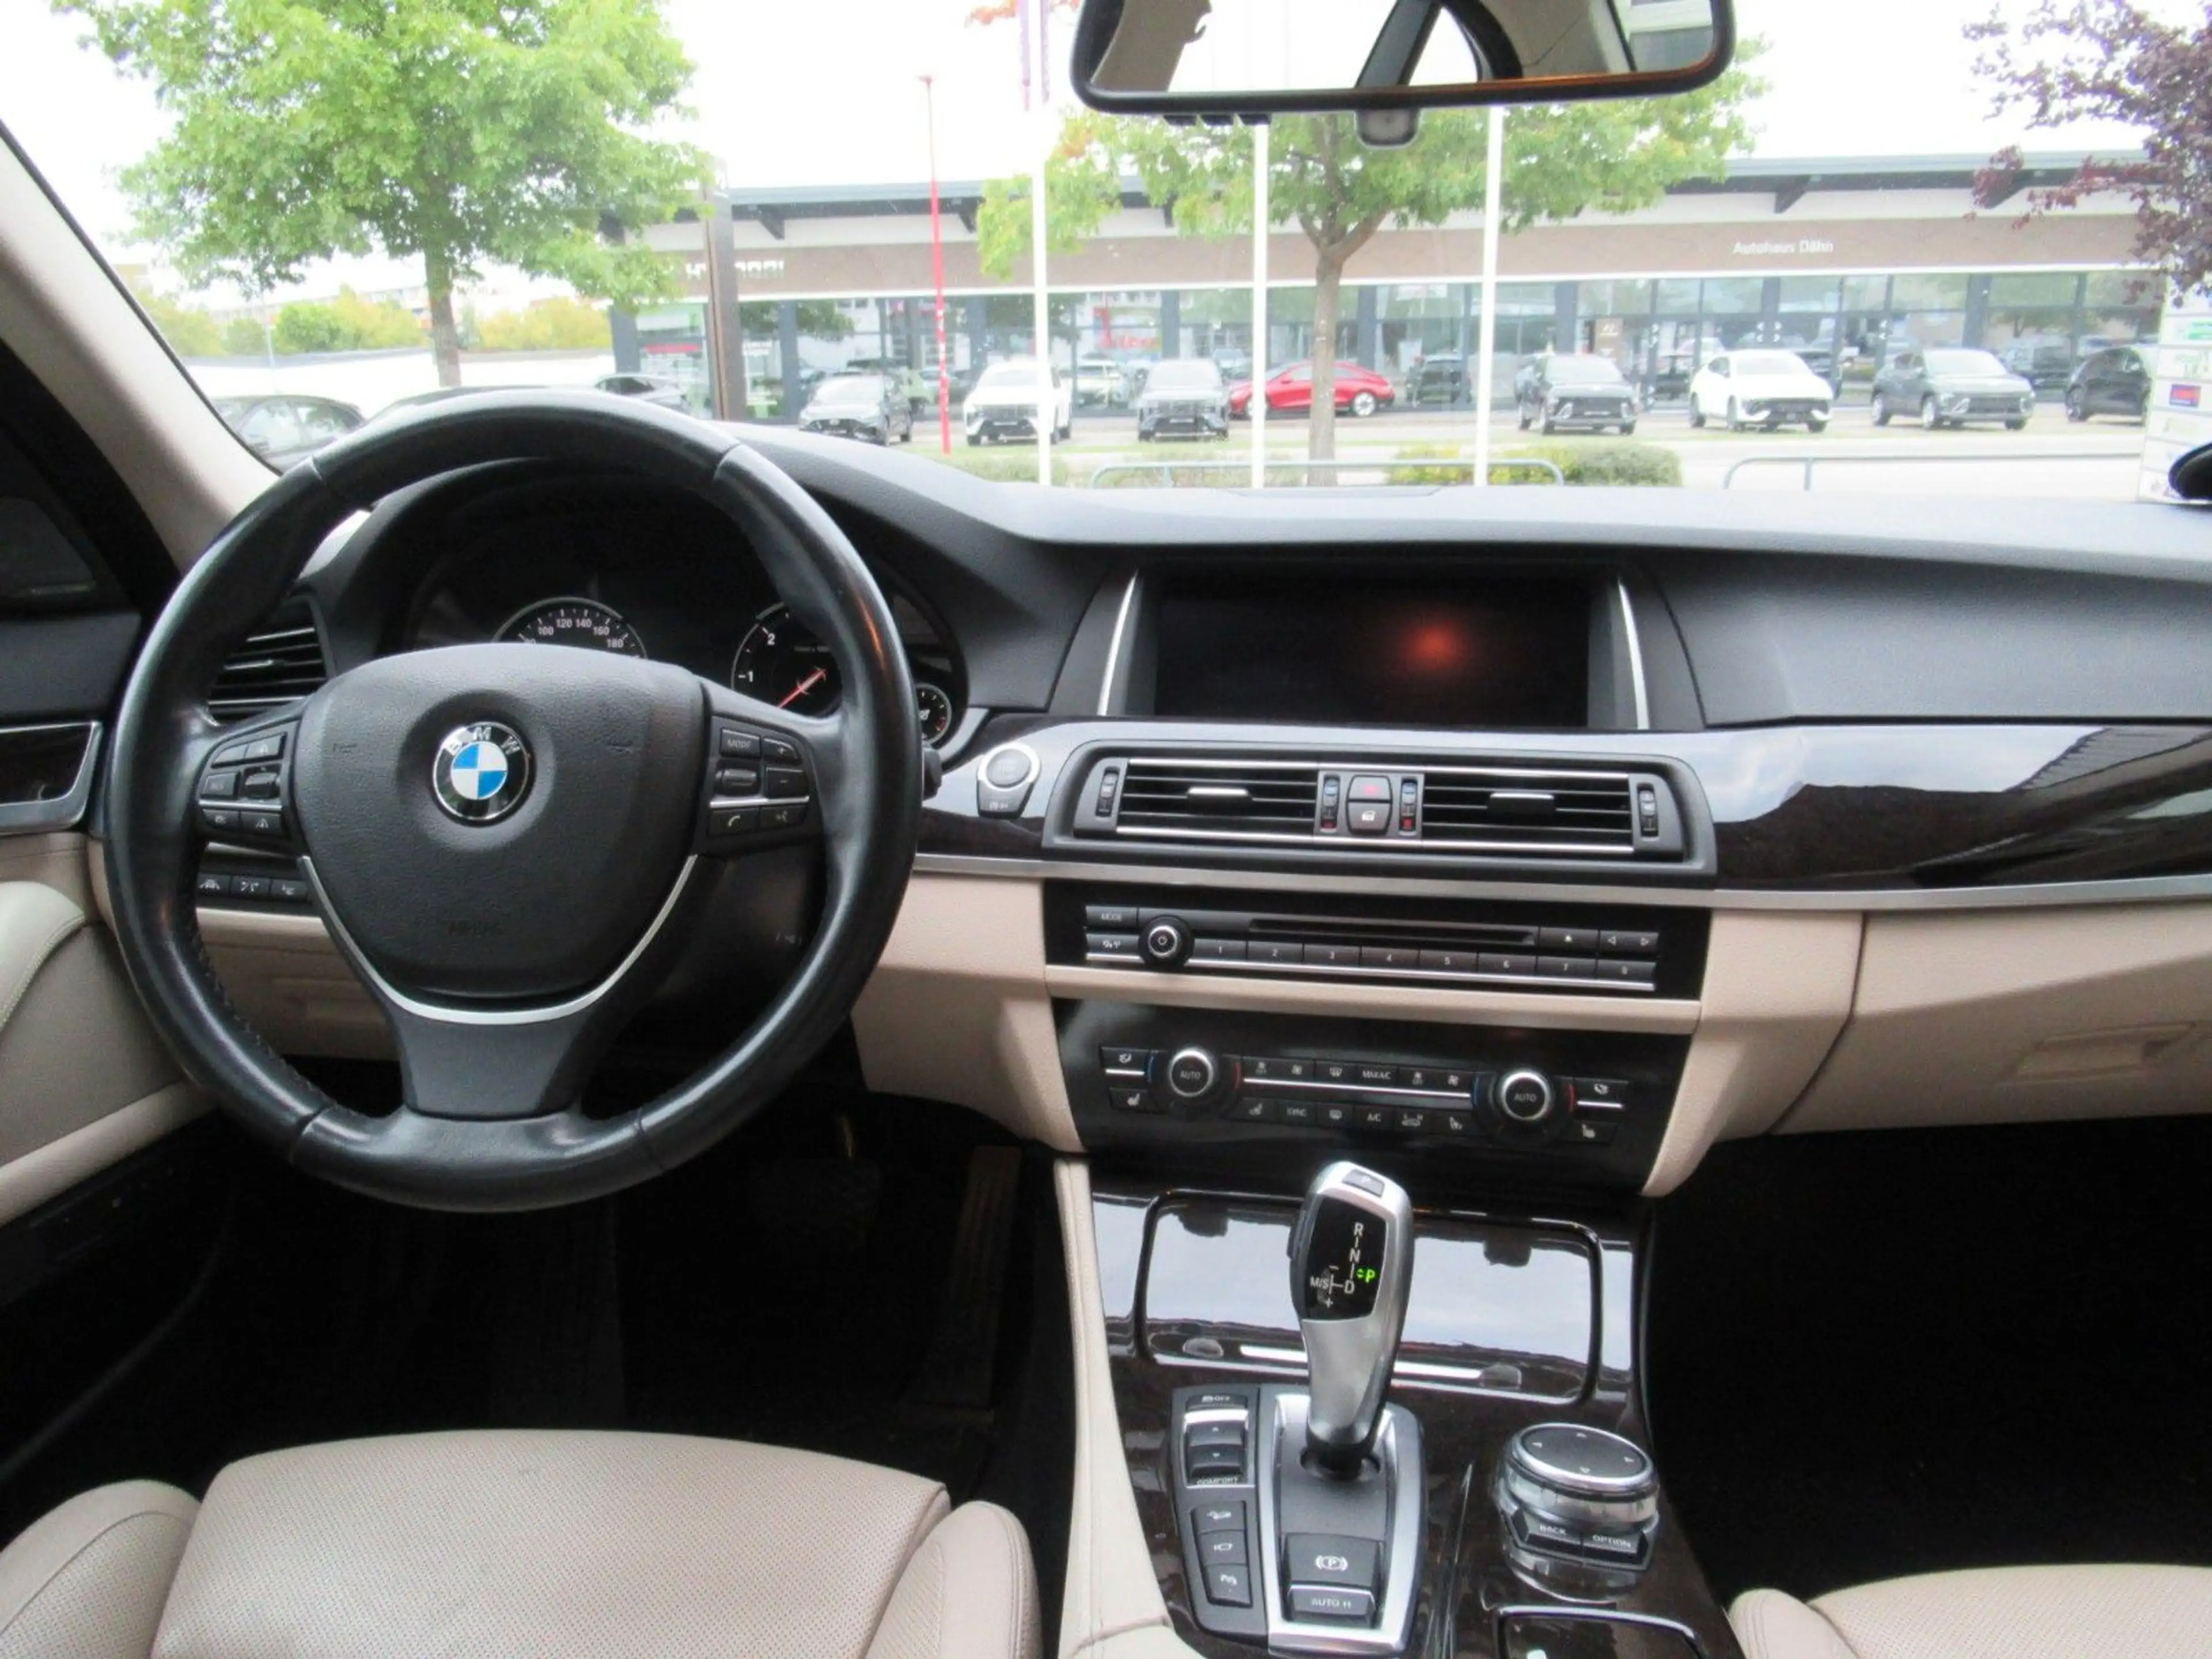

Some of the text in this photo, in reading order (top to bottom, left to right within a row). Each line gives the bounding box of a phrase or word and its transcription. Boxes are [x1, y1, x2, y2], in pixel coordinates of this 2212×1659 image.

[556, 619, 573, 628] 120
[576, 619, 592, 628] 140
[537, 626, 554, 635] 100
[767, 634, 775, 645] 2
[747, 671, 753, 683] 1
[445, 726, 521, 756] BMW
[1180, 1070, 1202, 1079] AUTO
[1514, 1093, 1536, 1103] AUTO
[1354, 1222, 1364, 1237] R
[1349, 1248, 1361, 1263] N
[1365, 1269, 1375, 1283] P
[1344, 1280, 1355, 1293] D
